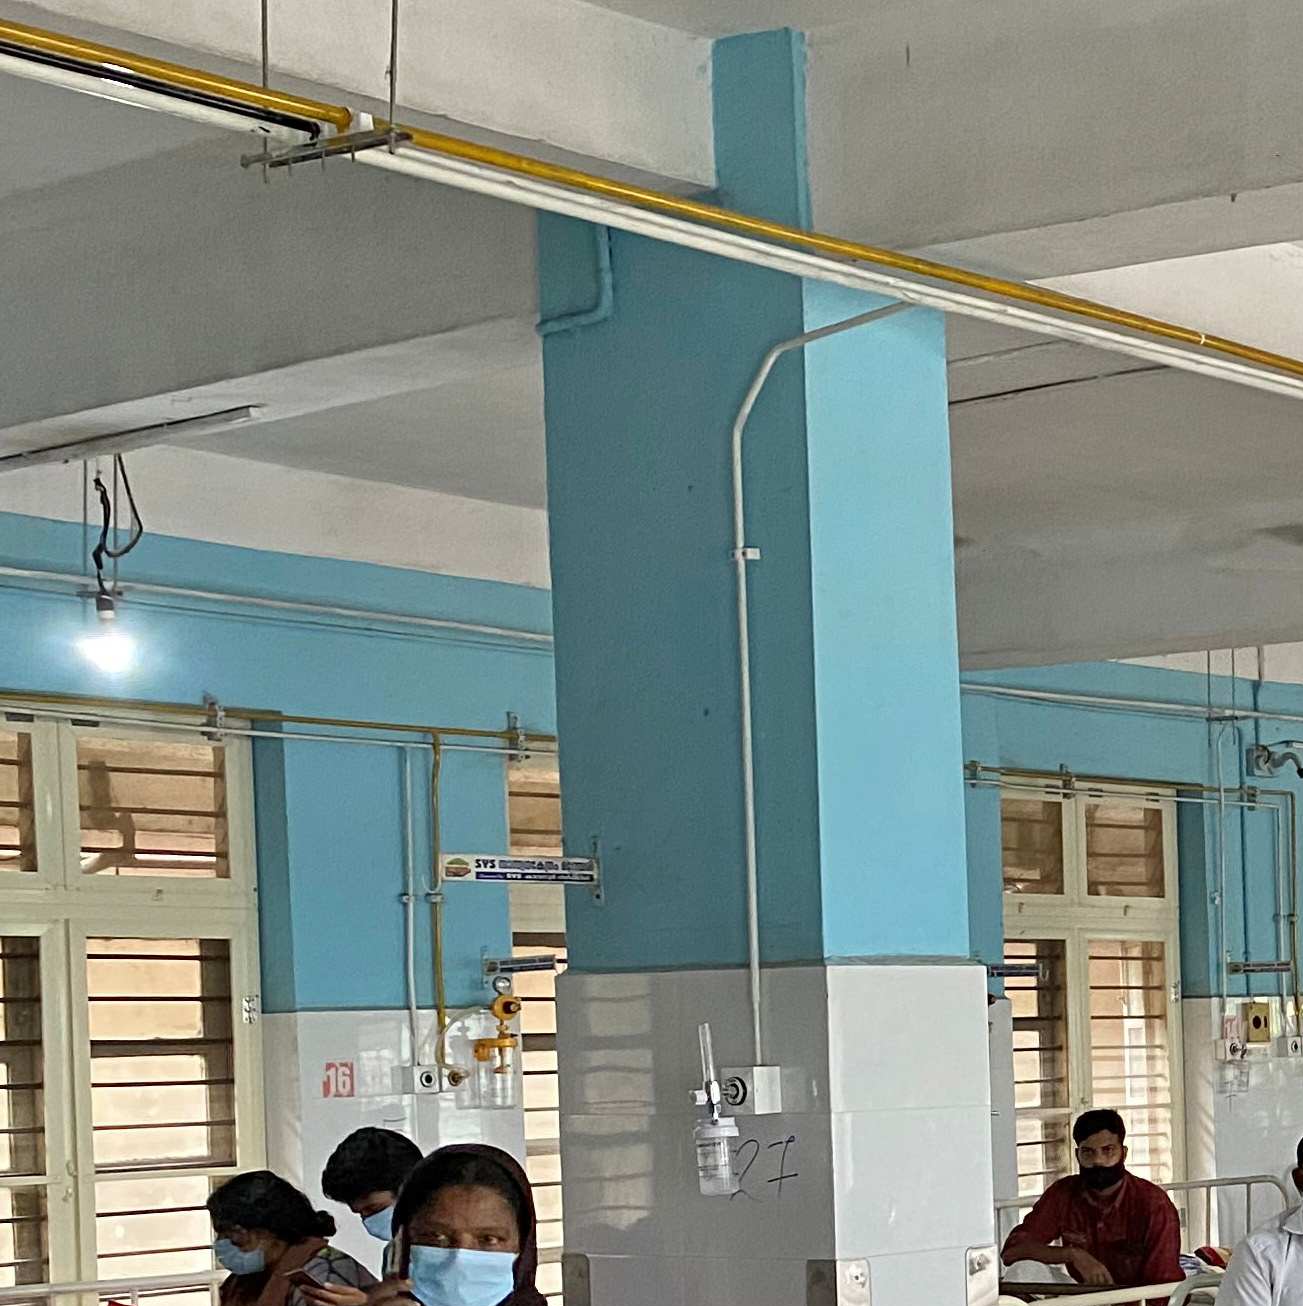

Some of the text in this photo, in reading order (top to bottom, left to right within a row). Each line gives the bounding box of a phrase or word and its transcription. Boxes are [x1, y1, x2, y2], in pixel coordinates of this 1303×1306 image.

[474, 858, 496, 869] SYS
[325, 1065, 352, 1098] 16
[729, 1135, 799, 1203] 27
